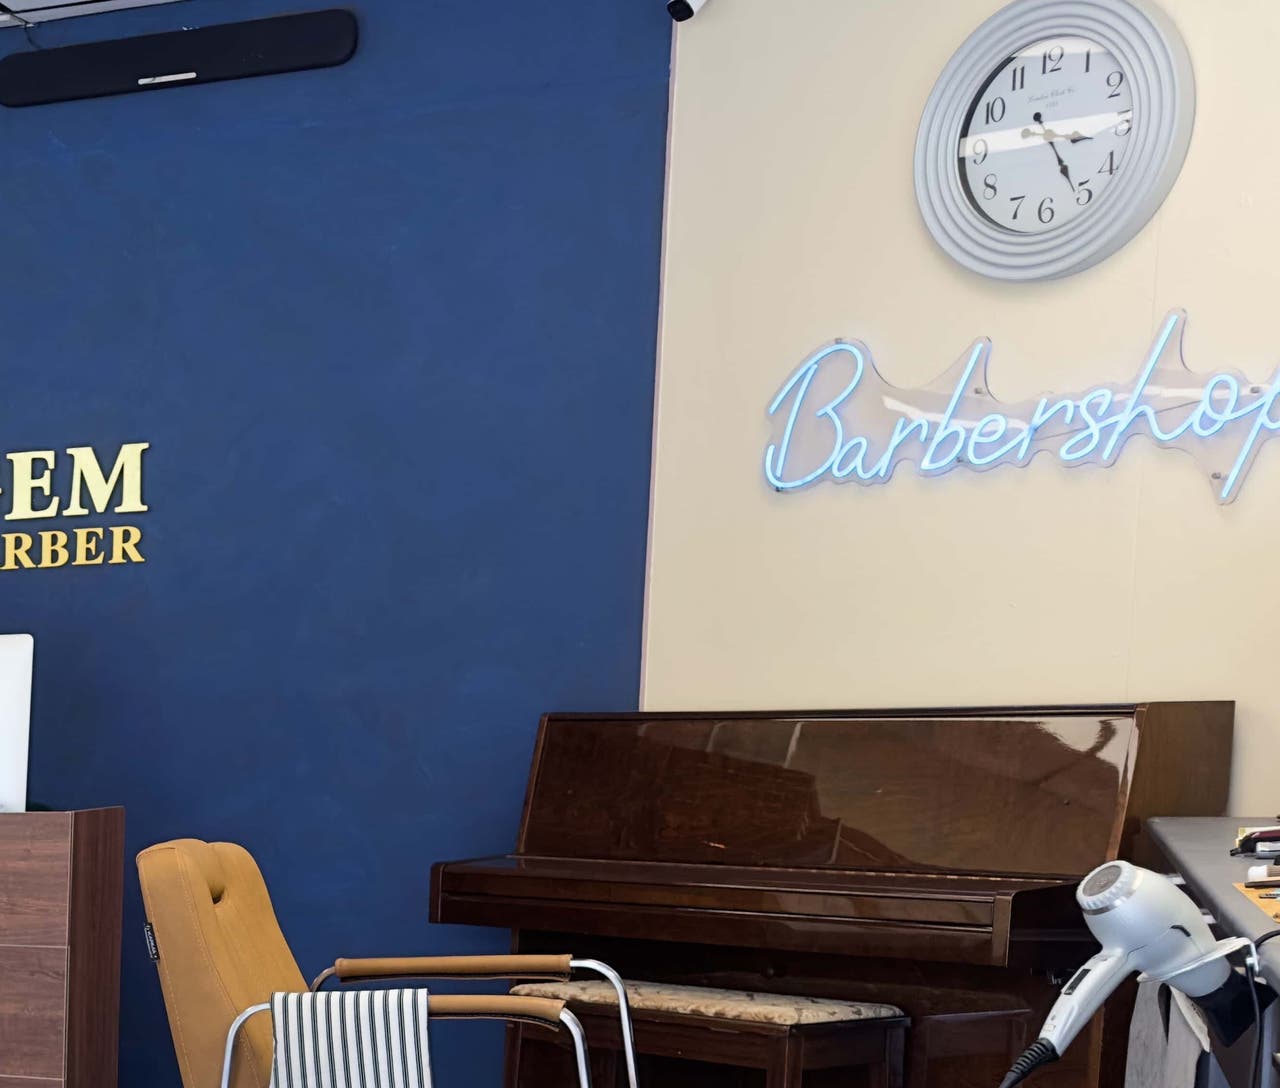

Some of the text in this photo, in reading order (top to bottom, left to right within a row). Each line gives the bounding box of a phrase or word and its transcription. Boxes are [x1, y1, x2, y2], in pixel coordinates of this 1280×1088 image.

[1041, 45, 1065, 75] 12
[1084, 48, 1091, 73] 1
[1011, 65, 1026, 92] 11
[1105, 70, 1125, 99] 2
[985, 96, 1006, 125] 10
[972, 138, 989, 166] 9
[1097, 150, 1121, 176] 4
[983, 173, 998, 200] 8
[1075, 179, 1093, 206] 5
[1009, 195, 1026, 220] 7
[1037, 197, 1055, 224] 6
